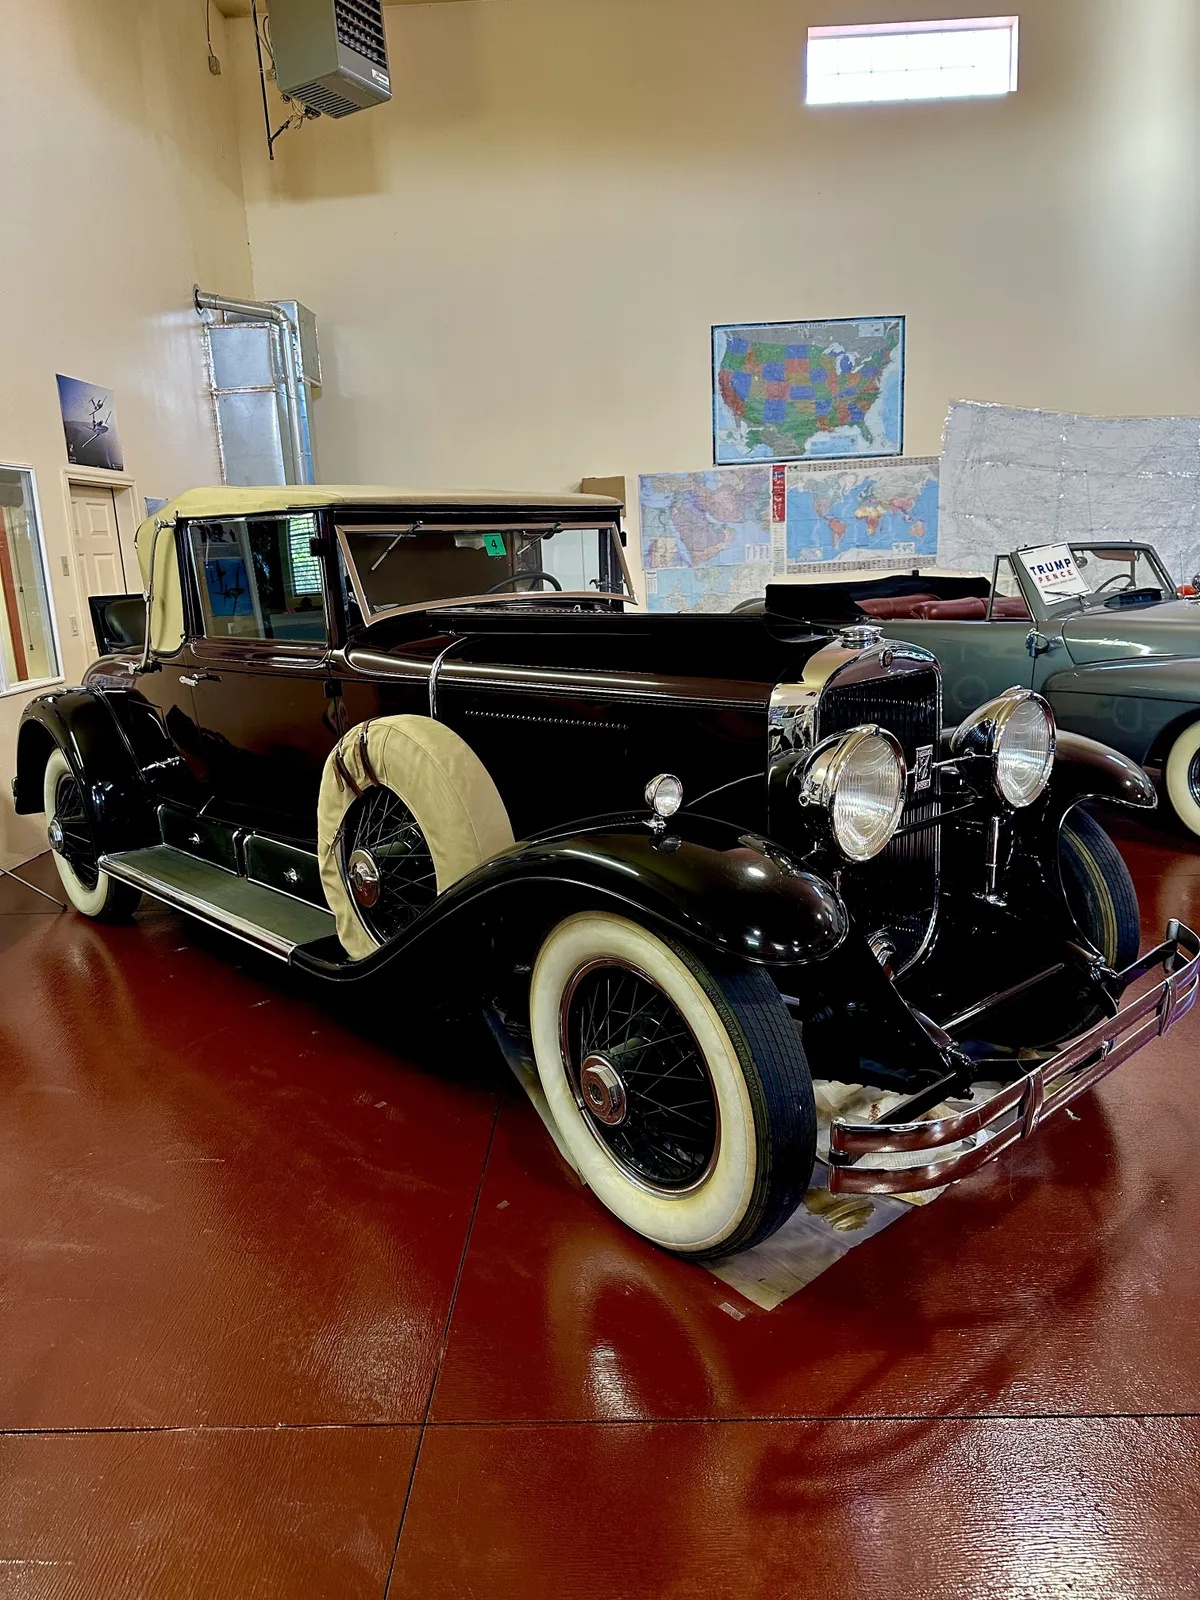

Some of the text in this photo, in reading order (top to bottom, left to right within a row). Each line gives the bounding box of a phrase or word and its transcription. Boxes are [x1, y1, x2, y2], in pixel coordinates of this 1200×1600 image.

[491, 539, 498, 549] 4
[1029, 558, 1071, 576] TRUMP
[1038, 569, 1074, 583] PENCE
